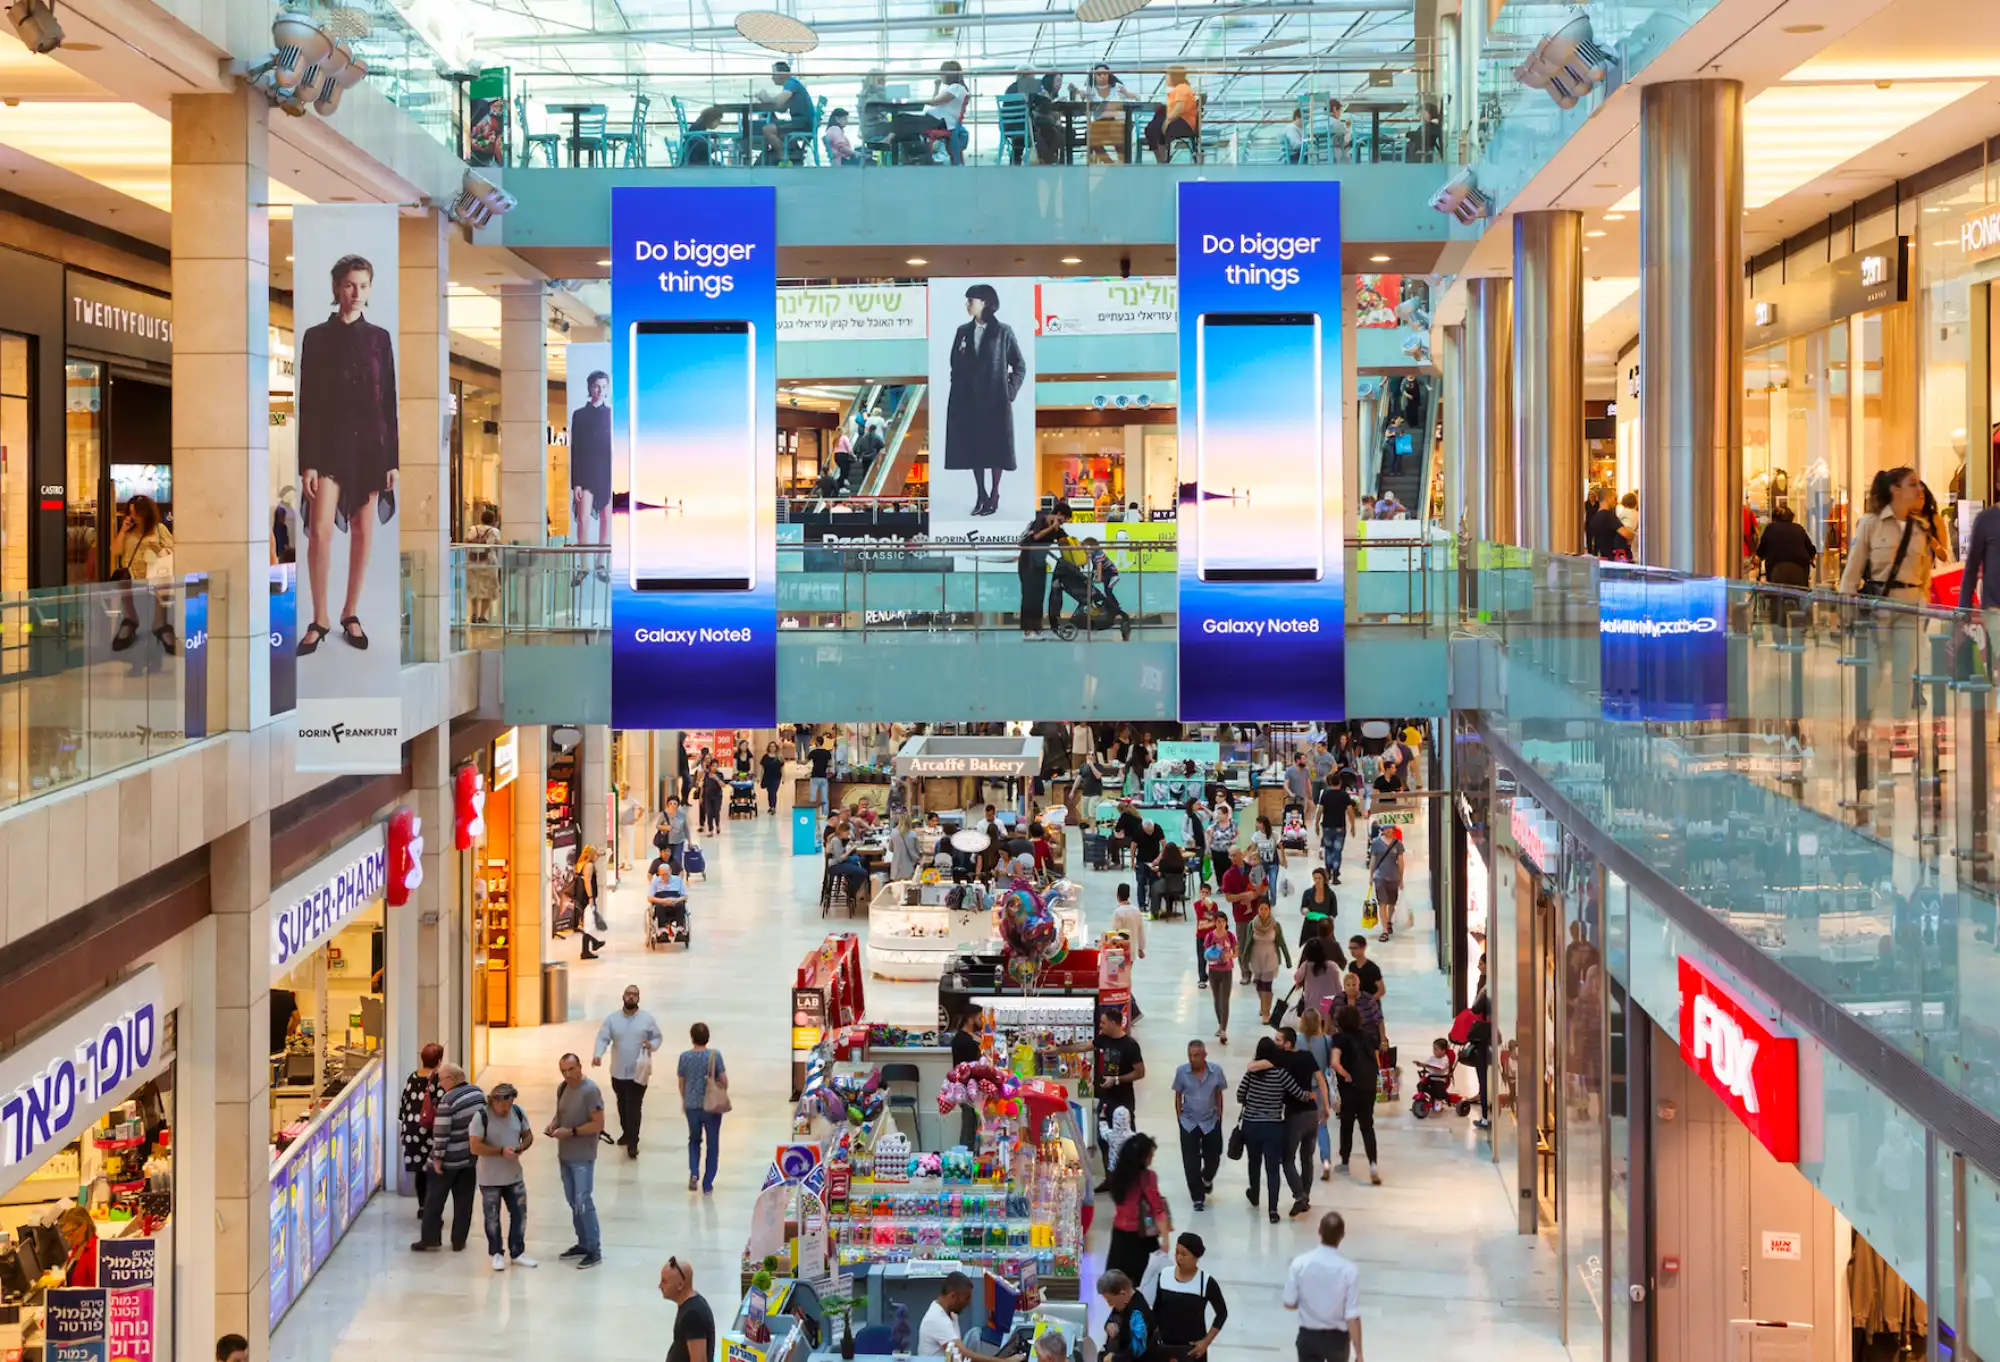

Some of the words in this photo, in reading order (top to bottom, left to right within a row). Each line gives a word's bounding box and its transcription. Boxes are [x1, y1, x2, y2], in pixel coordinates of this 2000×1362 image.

[635, 240, 668, 260] Do
[674, 238, 756, 267] bigger
[1203, 234, 1235, 254] Do
[1240, 232, 1321, 260] bigger
[658, 270, 734, 298] things
[1225, 263, 1300, 291] things
[848, 292, 902, 313] שישי
[850, 318, 865, 328] של
[858, 551, 905, 561] CLASSIC
[634, 628, 698, 646] Galaxy
[700, 627, 751, 642] Note8
[1202, 618, 1266, 637] Galaxy
[1268, 618, 1320, 633] Note8
[298, 729, 331, 738] DORIN
[331, 722, 398, 744] FRANKFURT
[969, 758, 1025, 775] Bakery
[796, 997, 819, 1007] LAB
[1693, 993, 1760, 1114] FOX
[101, 1255, 154, 1271] אקמולי
[111, 1268, 154, 1280] פורטה
[49, 1305, 104, 1321] אקמולי
[58, 1318, 104, 1332] פורטה
